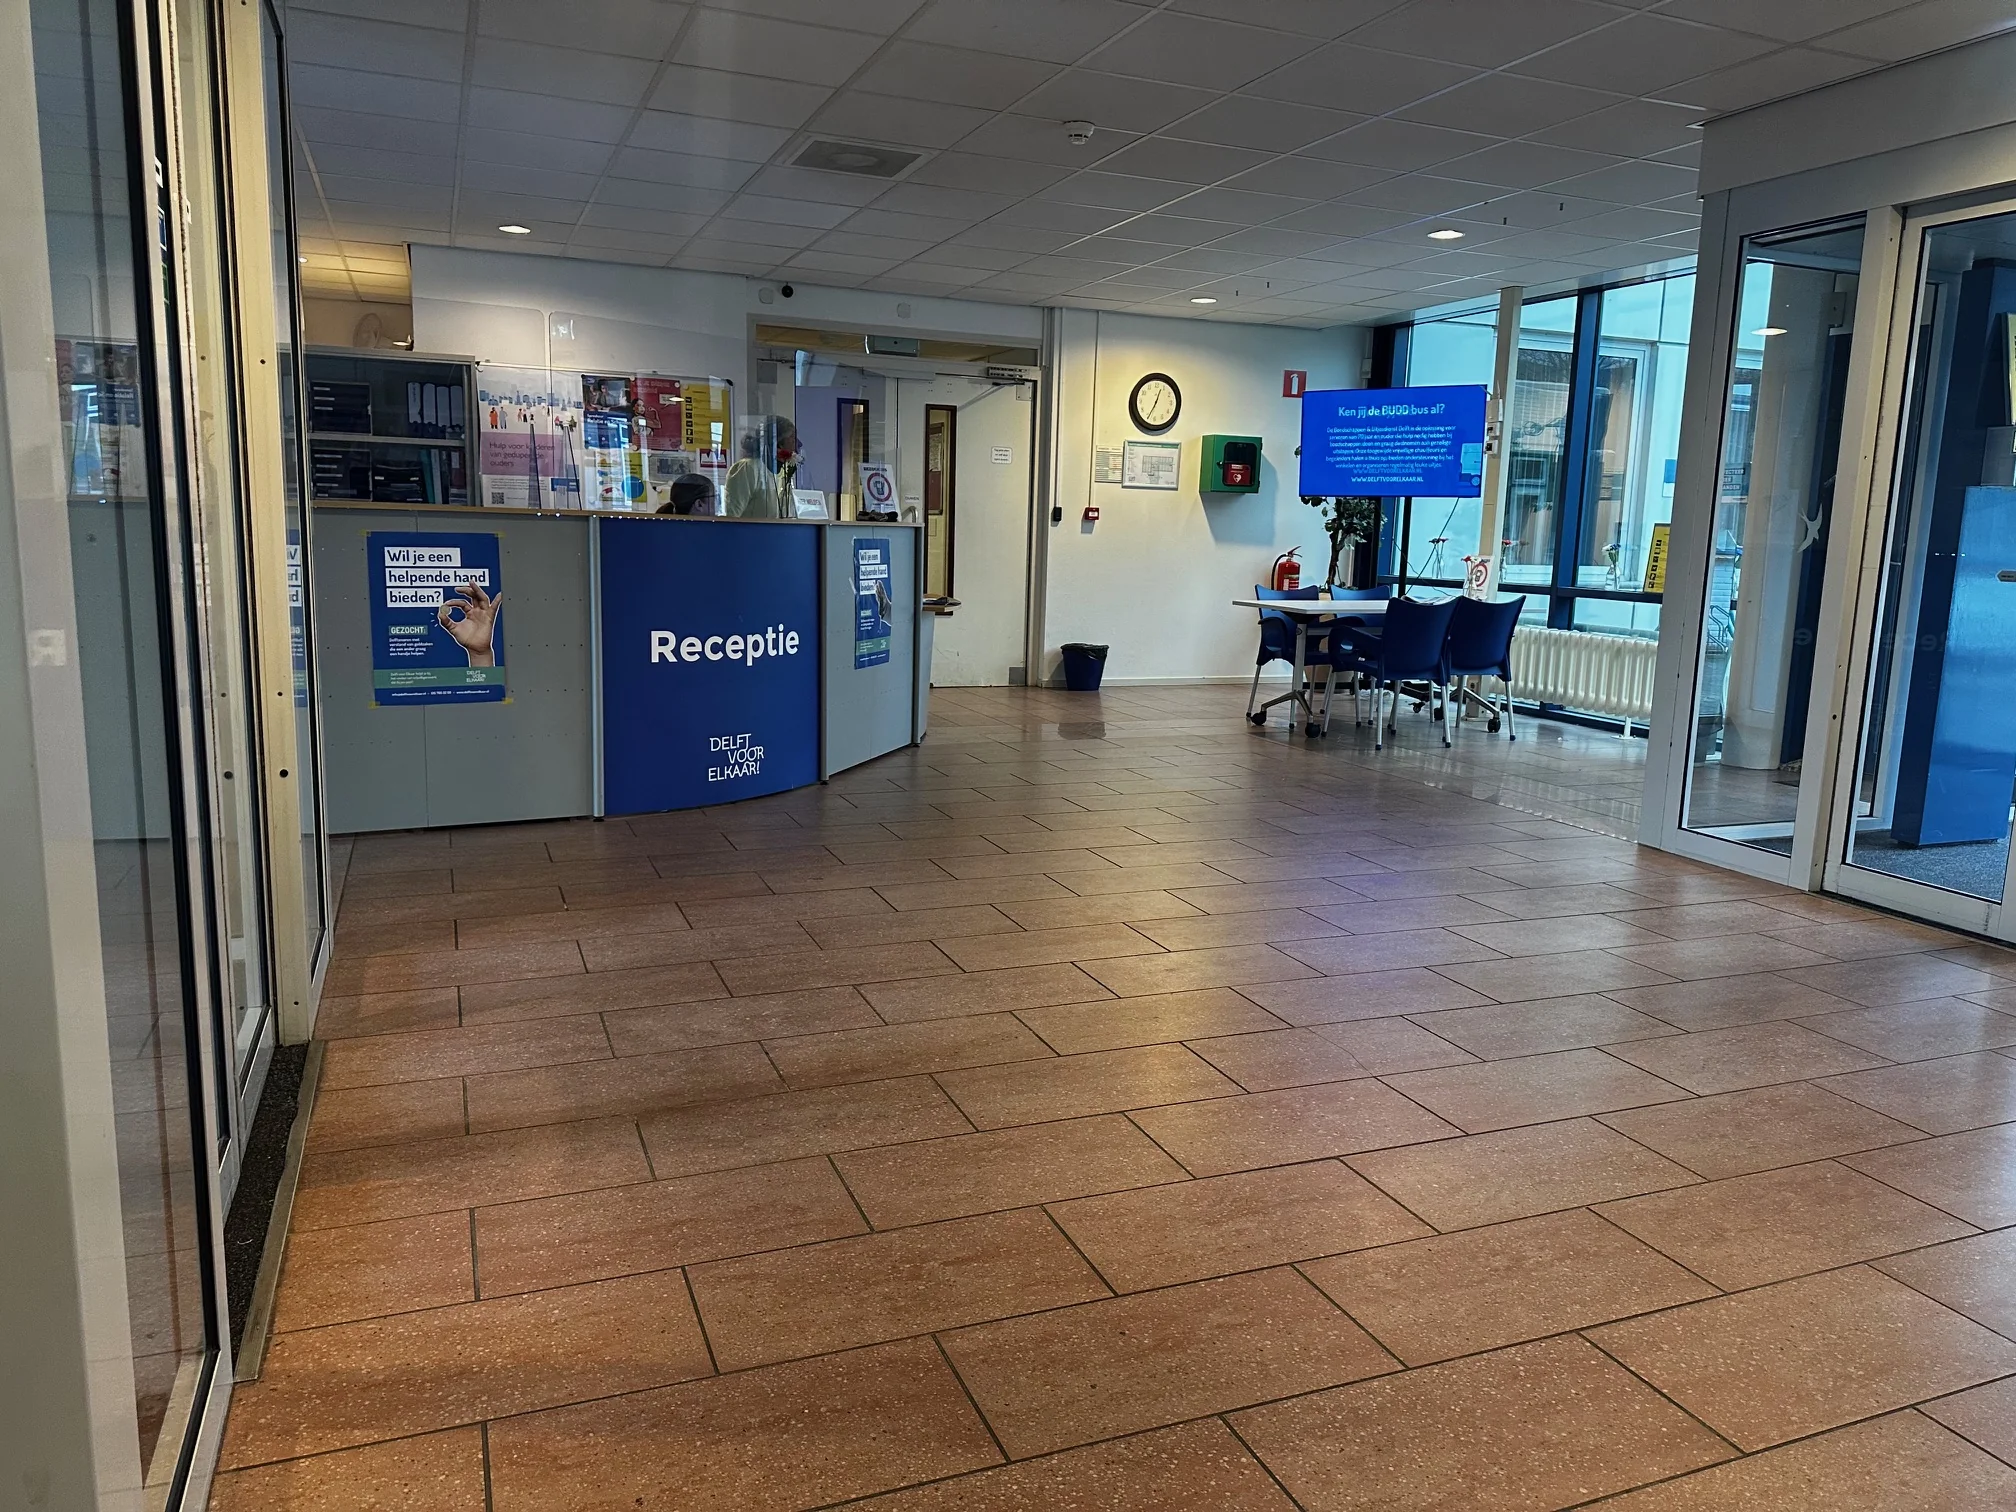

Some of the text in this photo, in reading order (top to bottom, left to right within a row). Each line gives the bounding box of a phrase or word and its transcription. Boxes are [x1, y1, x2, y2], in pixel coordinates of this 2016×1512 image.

[1338, 406, 1356, 417] Ken
[1368, 406, 1380, 416] de
[1382, 405, 1408, 416] BUDD
[1411, 404, 1428, 415] bus
[1430, 403, 1445, 414] al?
[490, 442, 506, 450] Hulp
[387, 550, 452, 565] Wil je een
[388, 570, 486, 585] helpende hand
[390, 590, 441, 603] bieden?
[650, 624, 800, 666] Receptie
[710, 734, 751, 752] DELFT
[728, 746, 764, 764] VOOR
[708, 760, 760, 781] ELKAAR!
